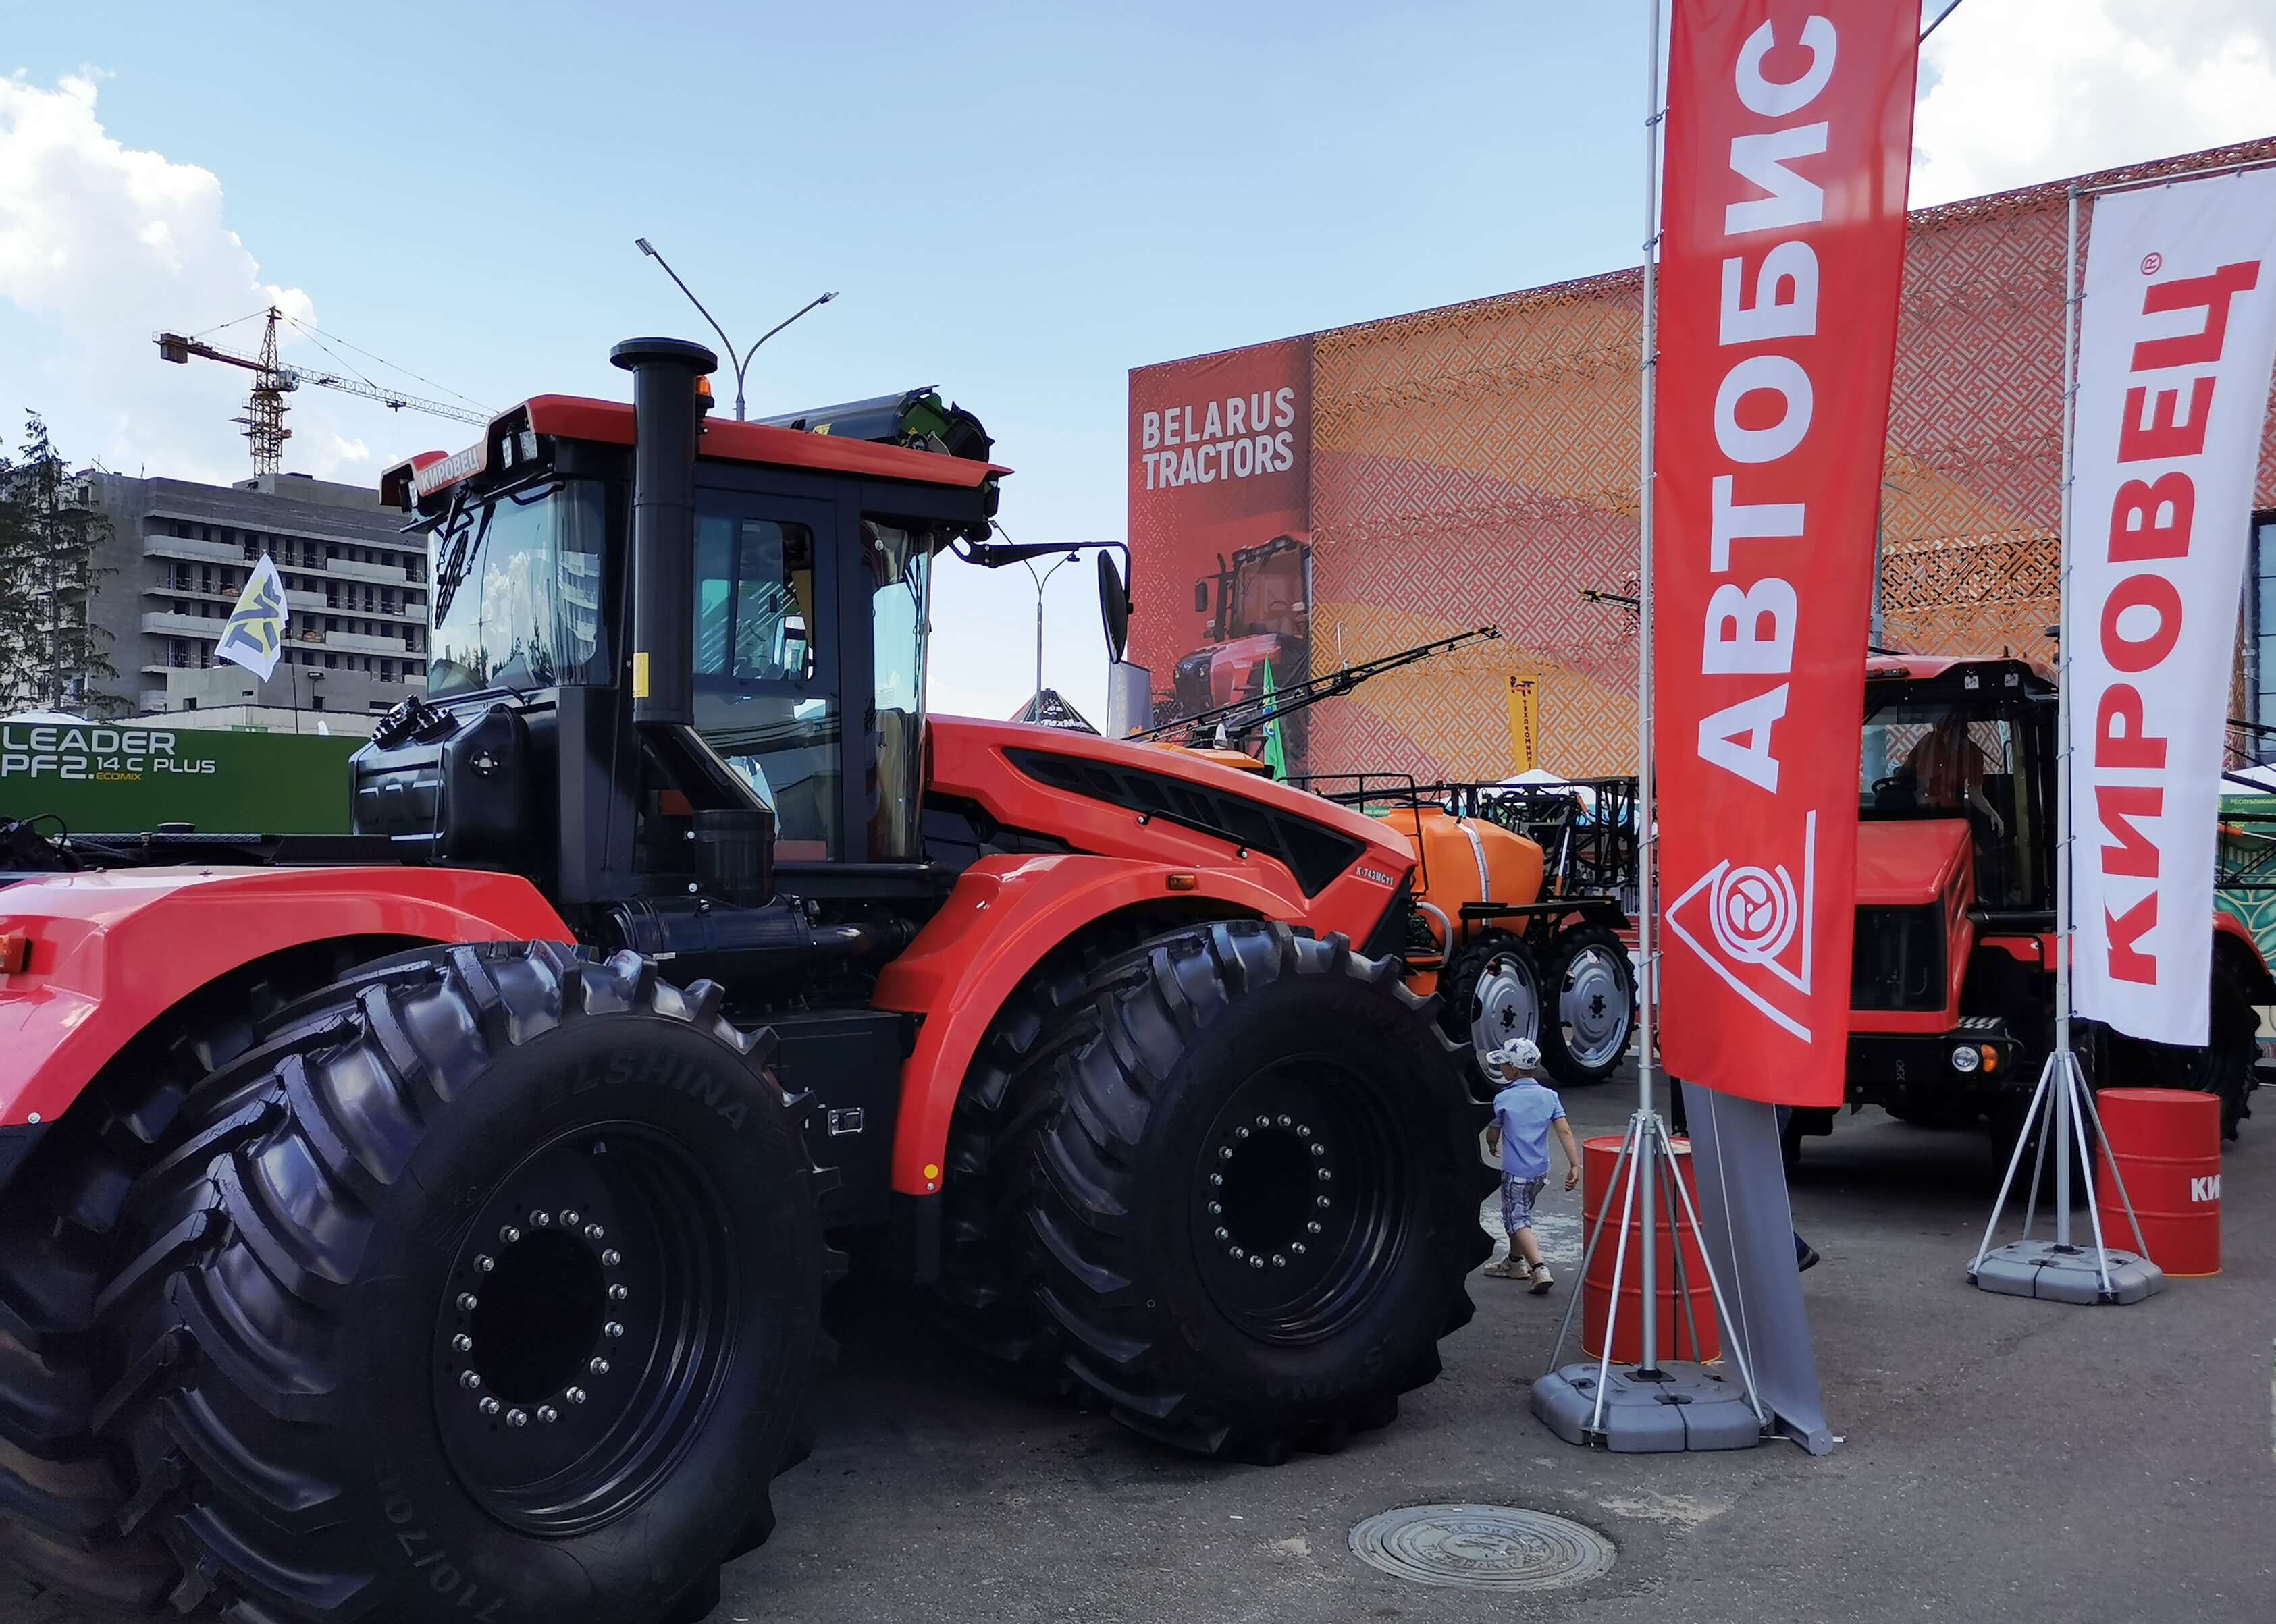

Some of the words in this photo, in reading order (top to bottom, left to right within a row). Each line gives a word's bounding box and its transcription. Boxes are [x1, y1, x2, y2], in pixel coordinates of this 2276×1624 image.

[1142, 387, 1295, 450] BELARUS
[1697, 14, 1838, 794] АВТОБИС
[421, 448, 480, 493] КИРОВЕЦ
[1142, 431, 1294, 491] TRACTORS
[2094, 259, 2262, 985] КИРОВЕЦ
[3, 726, 176, 755] LEADER
[126, 757, 144, 772] C
[153, 758, 216, 774] PLUS
[96, 772, 142, 781] ECOMIX
